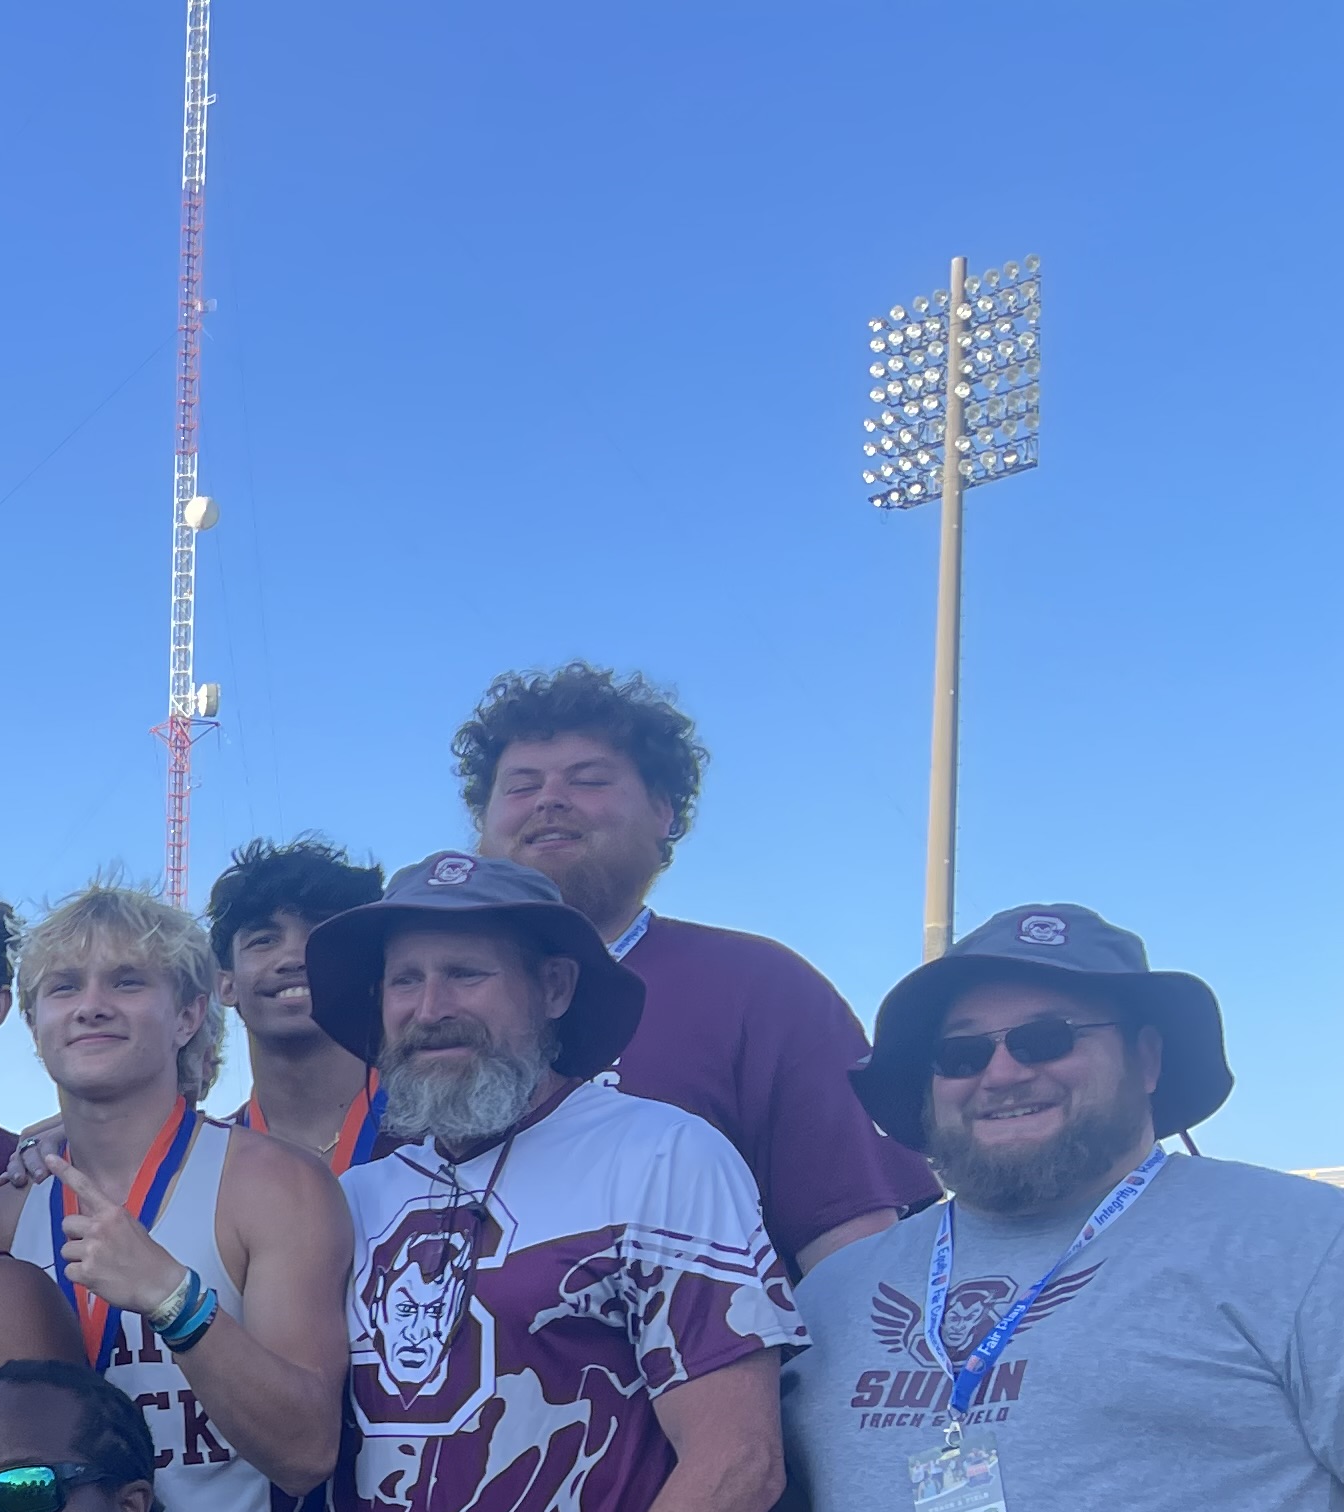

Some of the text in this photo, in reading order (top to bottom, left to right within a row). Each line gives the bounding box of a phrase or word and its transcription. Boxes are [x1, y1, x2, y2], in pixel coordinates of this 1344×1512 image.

[1094, 1185, 1138, 1226] Integrity
[977, 1303, 1026, 1356] Fair Play
[860, 1413, 925, 1429] TRACK
[932, 1414, 946, 1427] &
